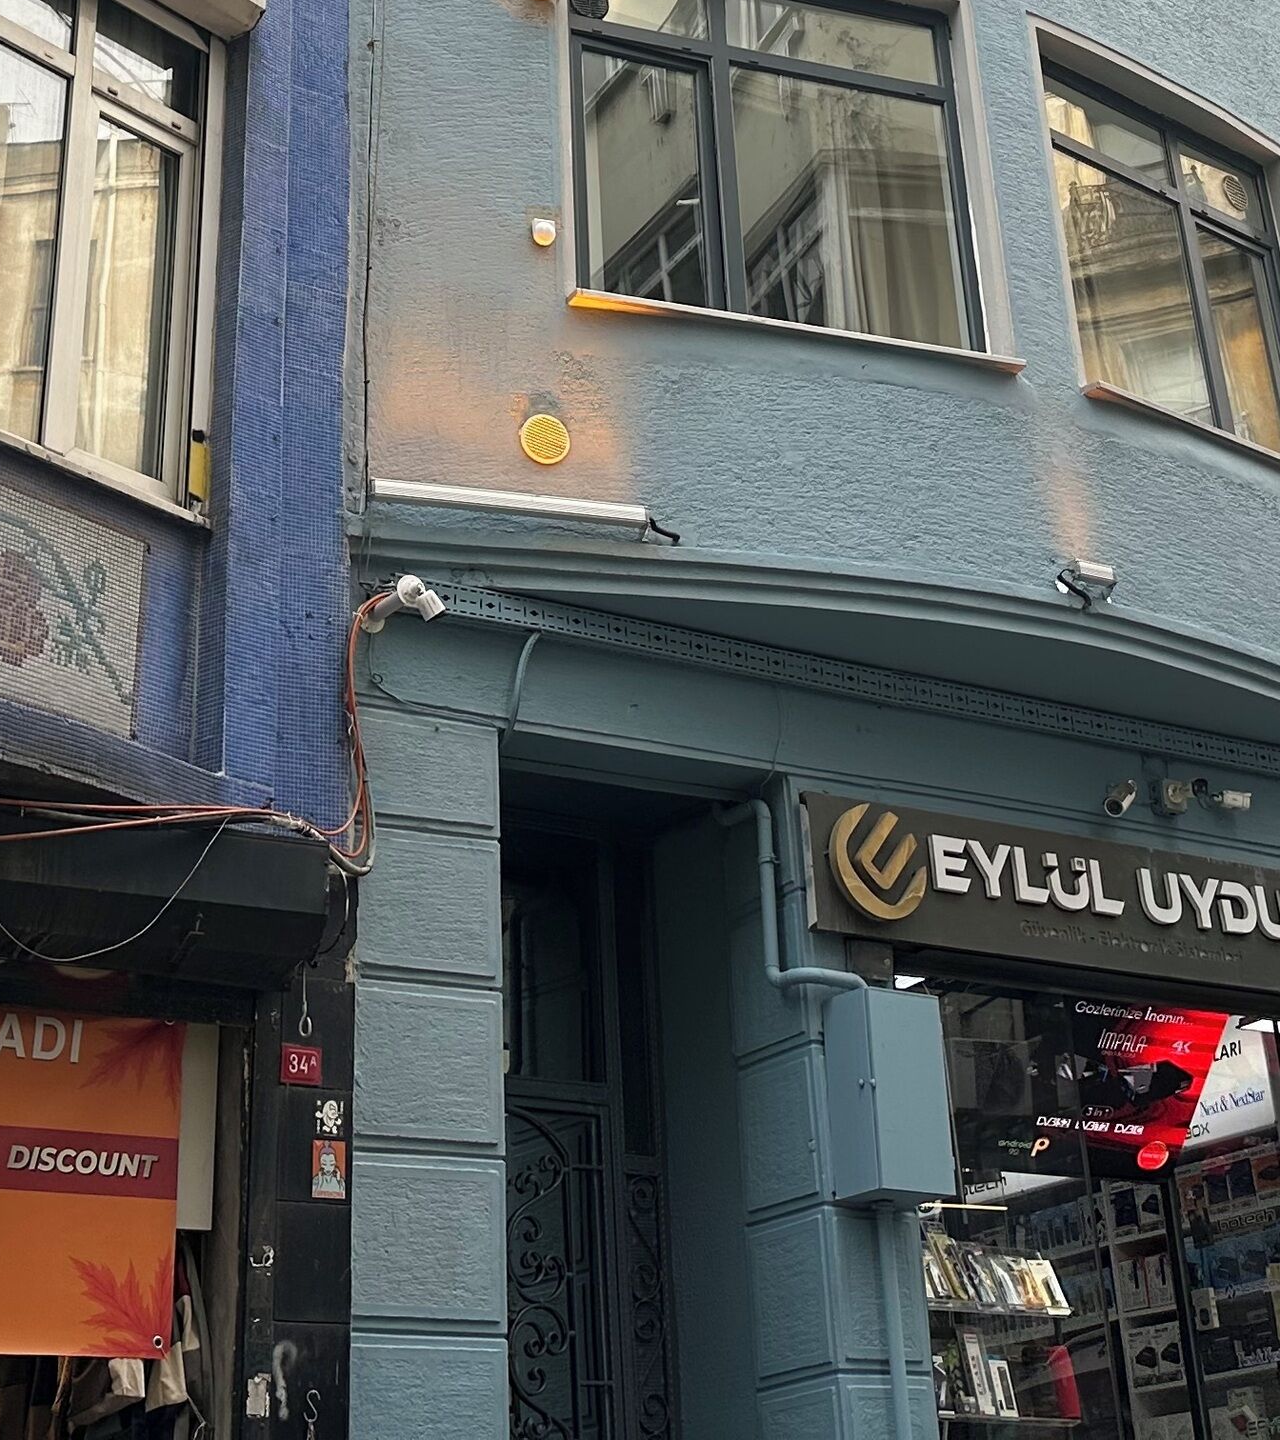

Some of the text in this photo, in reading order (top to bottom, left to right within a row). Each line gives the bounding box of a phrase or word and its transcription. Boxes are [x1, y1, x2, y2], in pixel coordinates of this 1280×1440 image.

[927, 833, 1124, 916] EYLÜL
[1097, 1028, 1148, 1053] IMPALA
[6, 1144, 158, 1178] DISCOUNT
